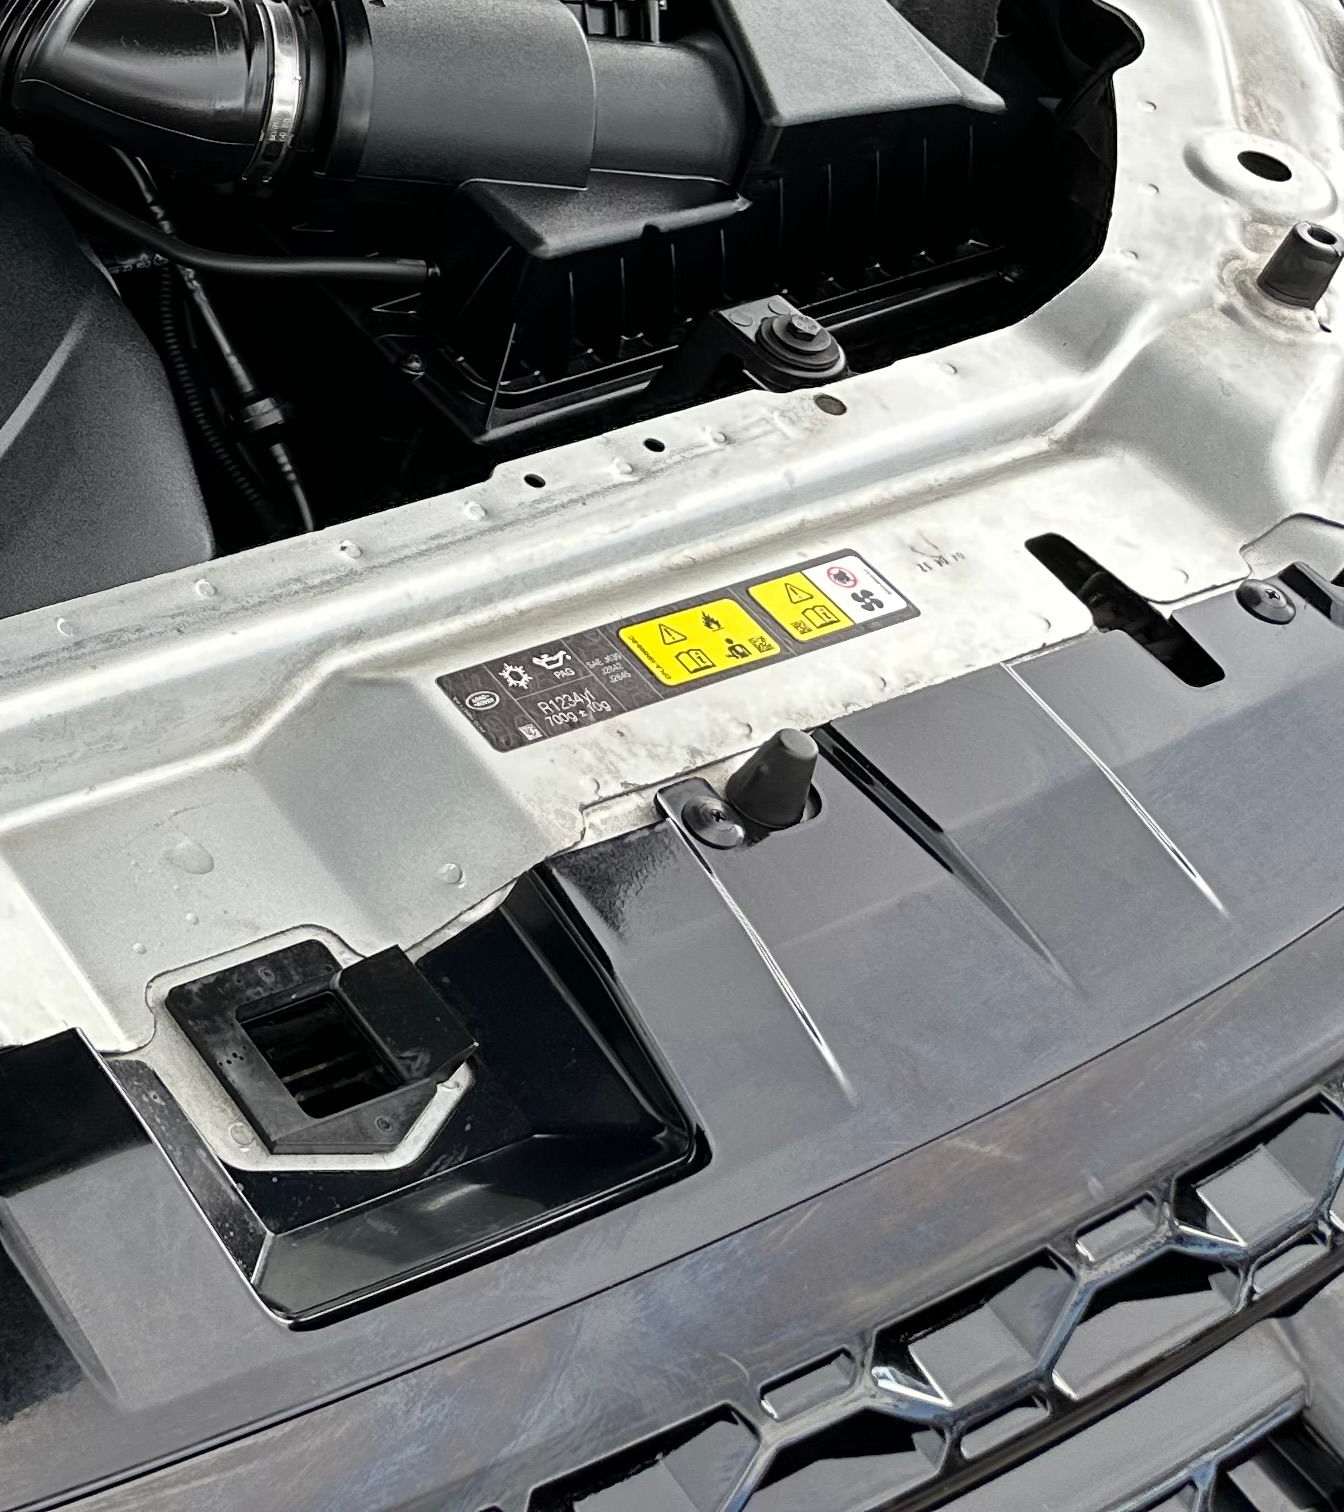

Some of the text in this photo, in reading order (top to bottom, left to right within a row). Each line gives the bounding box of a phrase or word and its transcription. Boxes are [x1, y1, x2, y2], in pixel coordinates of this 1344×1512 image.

[553, 667, 576, 679] PAG
[537, 687, 595, 714] R1234yf
[544, 711, 579, 727] 700g
[586, 700, 612, 713] 10g
